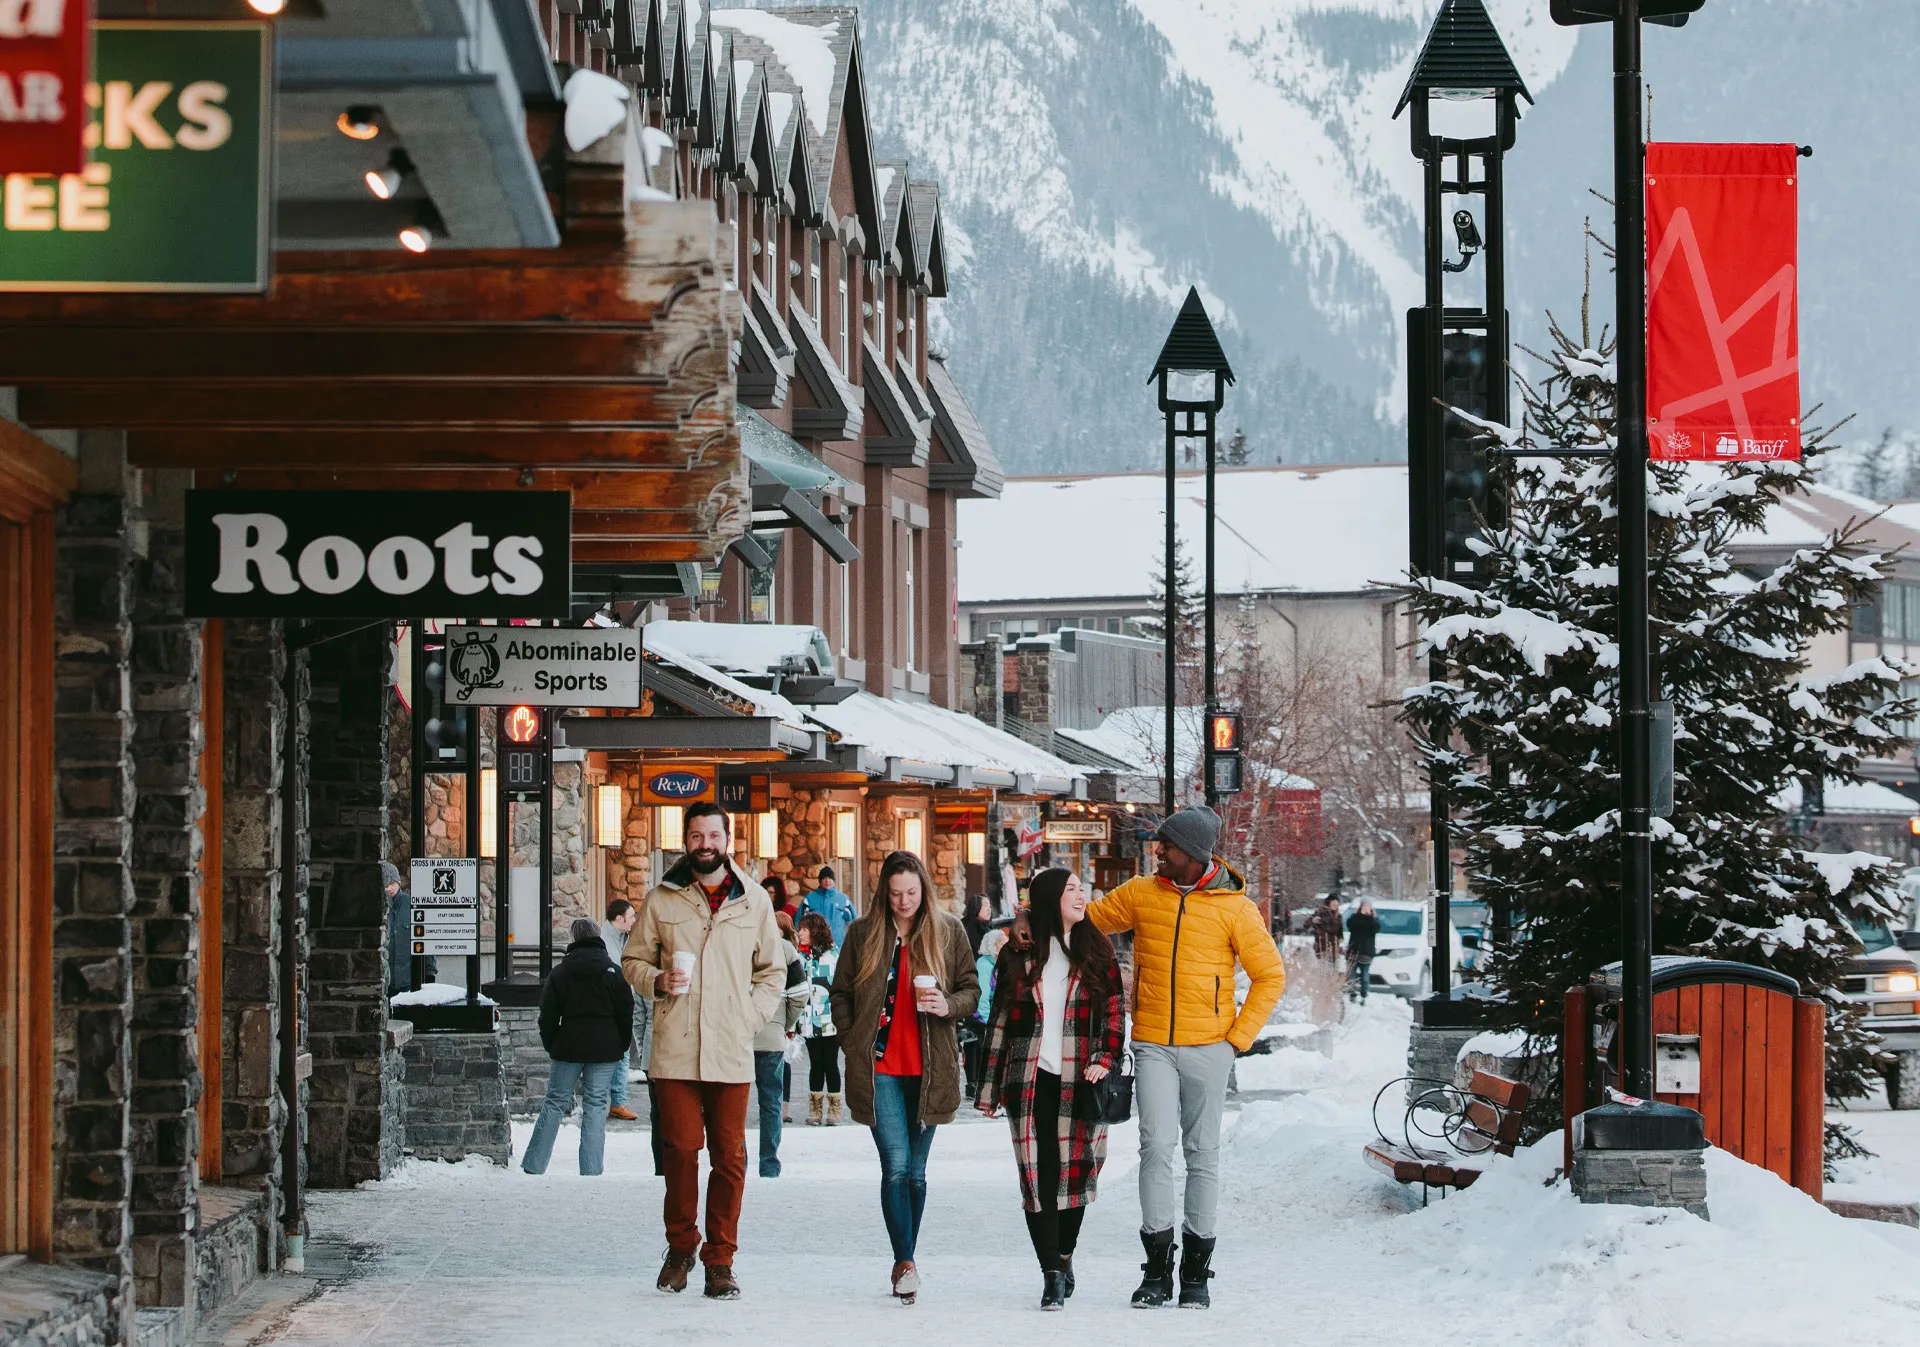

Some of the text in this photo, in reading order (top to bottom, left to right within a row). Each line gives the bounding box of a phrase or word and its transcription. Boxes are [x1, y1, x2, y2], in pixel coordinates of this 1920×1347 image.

[1742, 438, 1789, 459] Banff
[212, 513, 544, 596] Roots
[504, 640, 637, 662] Abominable
[534, 670, 608, 695] Sports
[657, 777, 700, 795] Rexall
[723, 785, 745, 801] GAP
[1048, 823, 1104, 833] RUNDLE GIFTS
